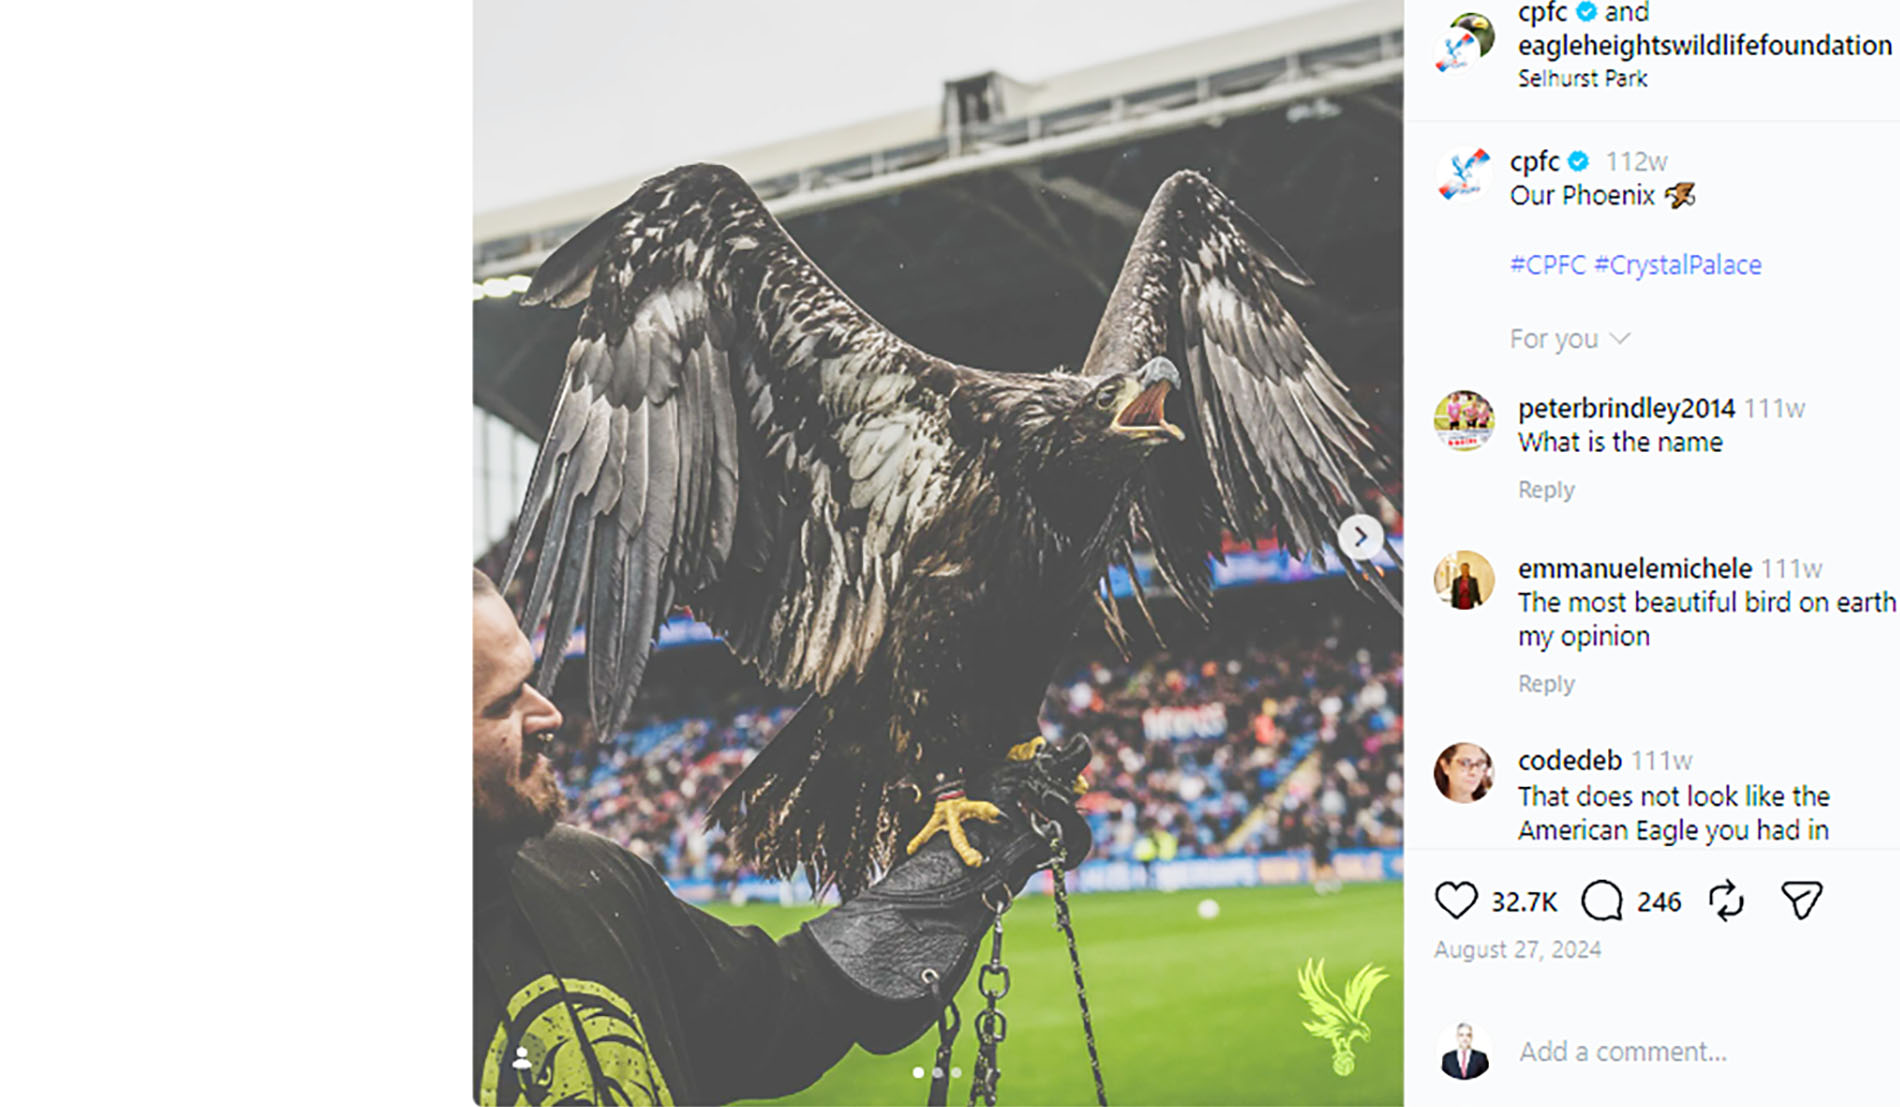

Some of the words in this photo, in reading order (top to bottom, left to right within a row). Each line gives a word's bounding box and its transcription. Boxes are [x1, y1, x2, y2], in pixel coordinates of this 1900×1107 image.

[1518, 0, 1568, 28] cpfc
[1604, 0, 1649, 22] and
[1518, 33, 1892, 62] eagleheightswildlifefoundation
[1518, 69, 1599, 87] Selhurst
[1605, 69, 1648, 87] Park
[1510, 149, 1560, 178] cpfc
[1608, 151, 1668, 171] 112w
[1510, 185, 1556, 205] Our
[1562, 183, 1655, 206] Phoenix
[1511, 255, 1586, 275] #CPFC
[1595, 253, 1762, 281] #CrystalPalace
[1511, 328, 1548, 349] For
[1555, 333, 1598, 355] you
[1519, 396, 1736, 425] peterbrindley2014
[1746, 398, 1805, 418] 111w
[1517, 430, 1580, 452] What
[1589, 430, 1606, 452] is
[1612, 430, 1650, 452] the
[1658, 436, 1723, 452] name
[1519, 480, 1576, 503] Reply
[1518, 556, 1753, 579] emmanuelemichele
[1762, 559, 1823, 578] 111w
[1518, 590, 1561, 613] The
[1568, 592, 1626, 613] most
[1635, 590, 1736, 613] beautiful
[1745, 590, 1791, 613] bird
[1799, 596, 1829, 613] on
[1836, 590, 1896, 613] earth
[1519, 630, 1554, 652] my
[1560, 624, 1650, 652] opinion
[1519, 674, 1576, 696] Reply
[1518, 748, 1622, 771] codedeb
[1632, 751, 1693, 770] 111w
[1518, 784, 1569, 807] That
[1576, 784, 1633, 807] does
[1641, 786, 1680, 807] not
[1688, 784, 1738, 807] look
[1745, 784, 1785, 807] like
[1792, 784, 1831, 807] the
[1517, 818, 1628, 840] American
[1636, 818, 1698, 846] Eagle
[1705, 824, 1749, 846] you
[1757, 818, 1800, 840] had
[1808, 818, 1829, 840] in
[1492, 892, 1558, 912] 32.7K
[1638, 892, 1682, 912] 246
[1433, 941, 1507, 962] August
[1514, 940, 1544, 961] 27,
[1552, 940, 1602, 958] 2024
[1520, 1040, 1567, 1062] Add
[1575, 1046, 1588, 1061] a
[1596, 1042, 1727, 1062] comment...
